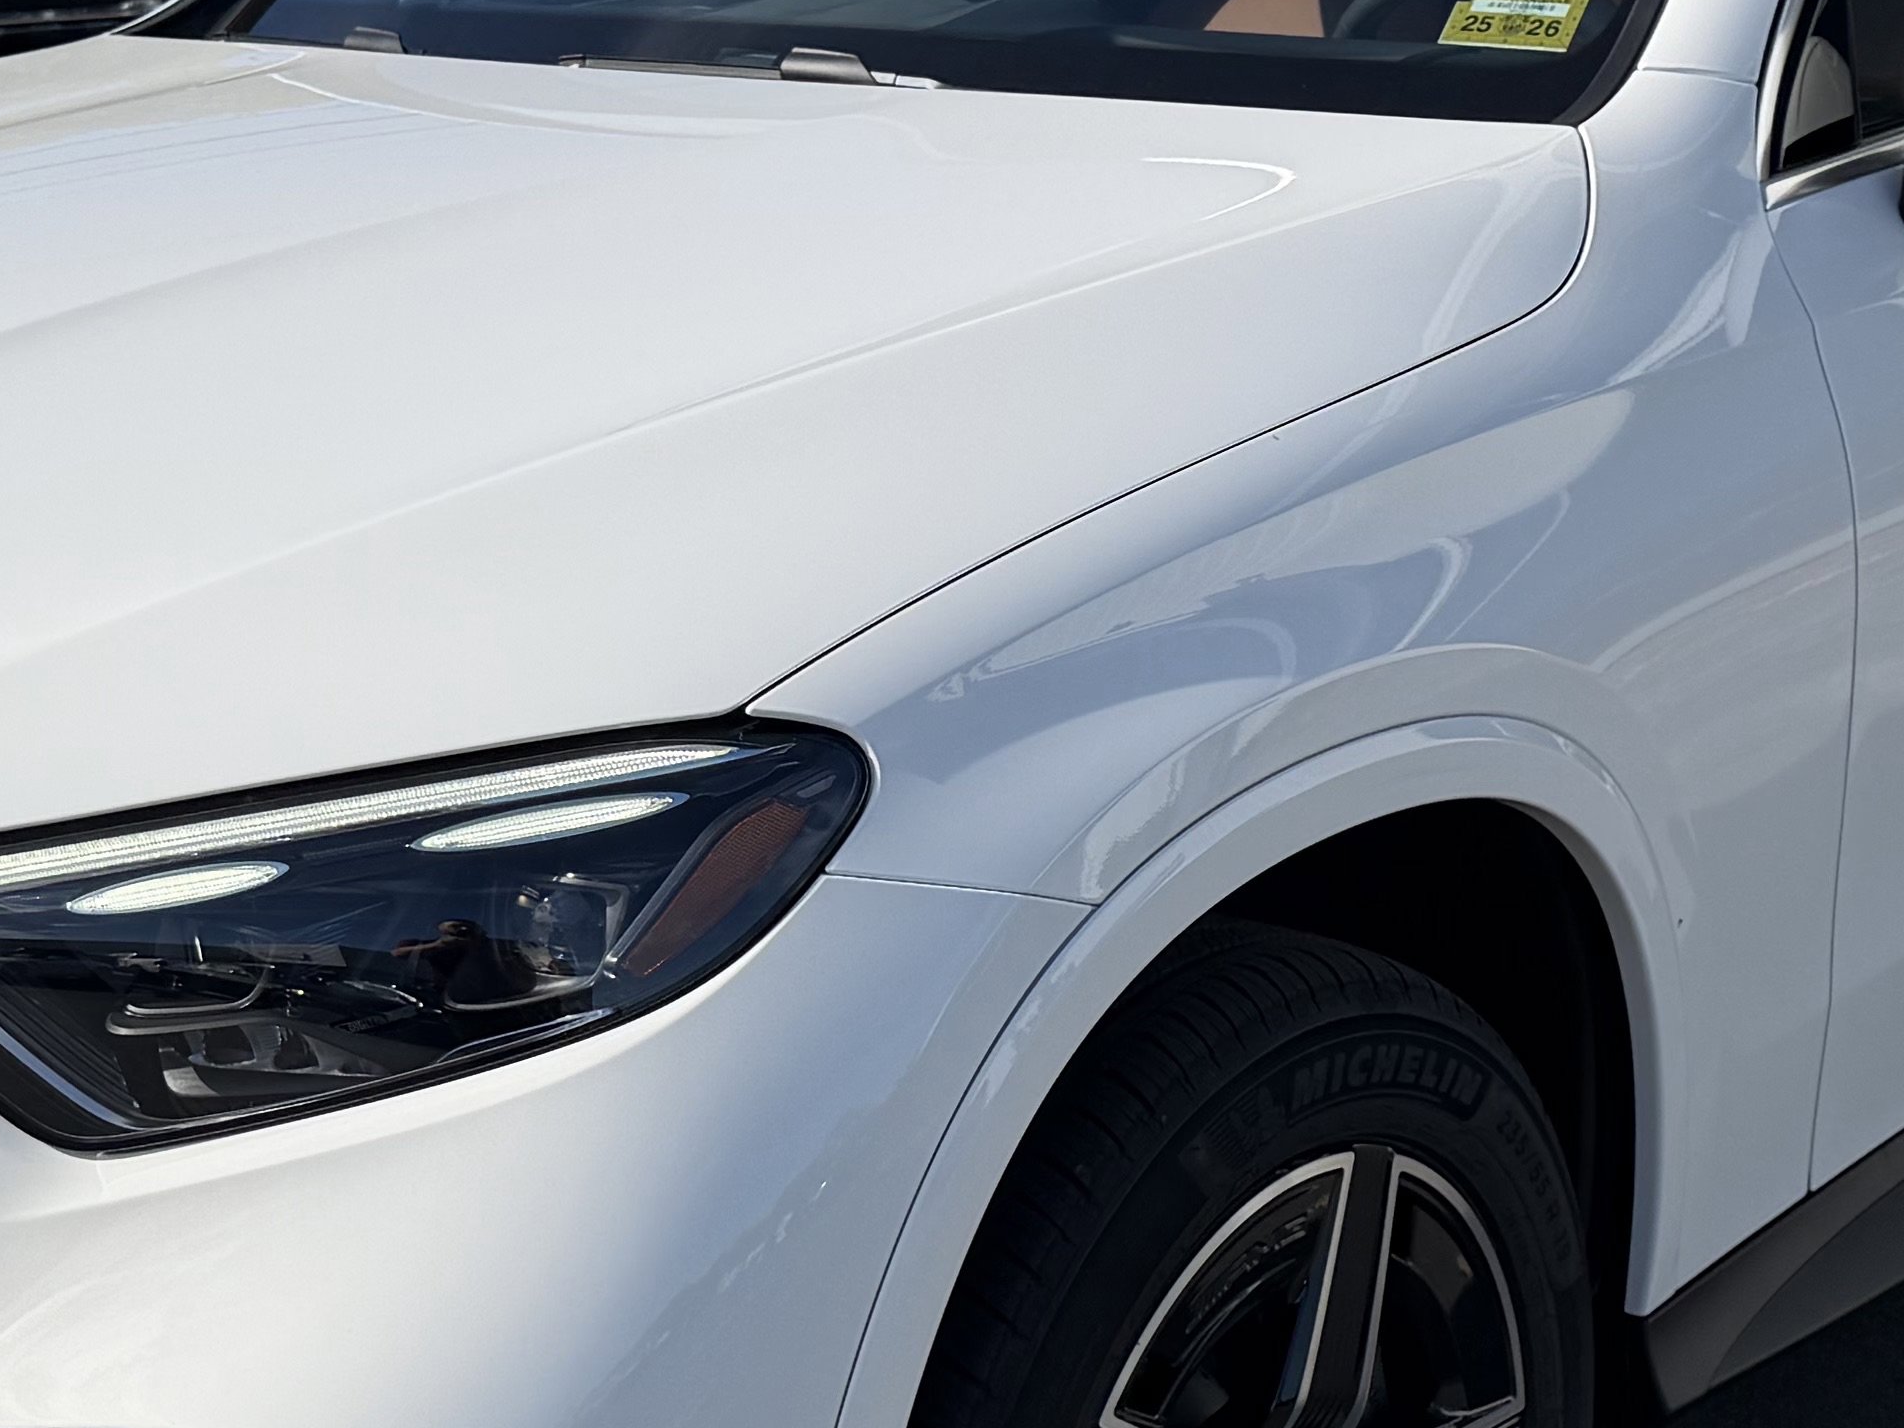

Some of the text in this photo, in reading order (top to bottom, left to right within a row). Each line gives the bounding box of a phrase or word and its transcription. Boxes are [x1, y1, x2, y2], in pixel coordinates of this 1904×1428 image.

[1460, 15, 1495, 32] 25
[1525, 19, 1562, 37] 26
[1291, 1044, 1486, 1111] MICHELIN
